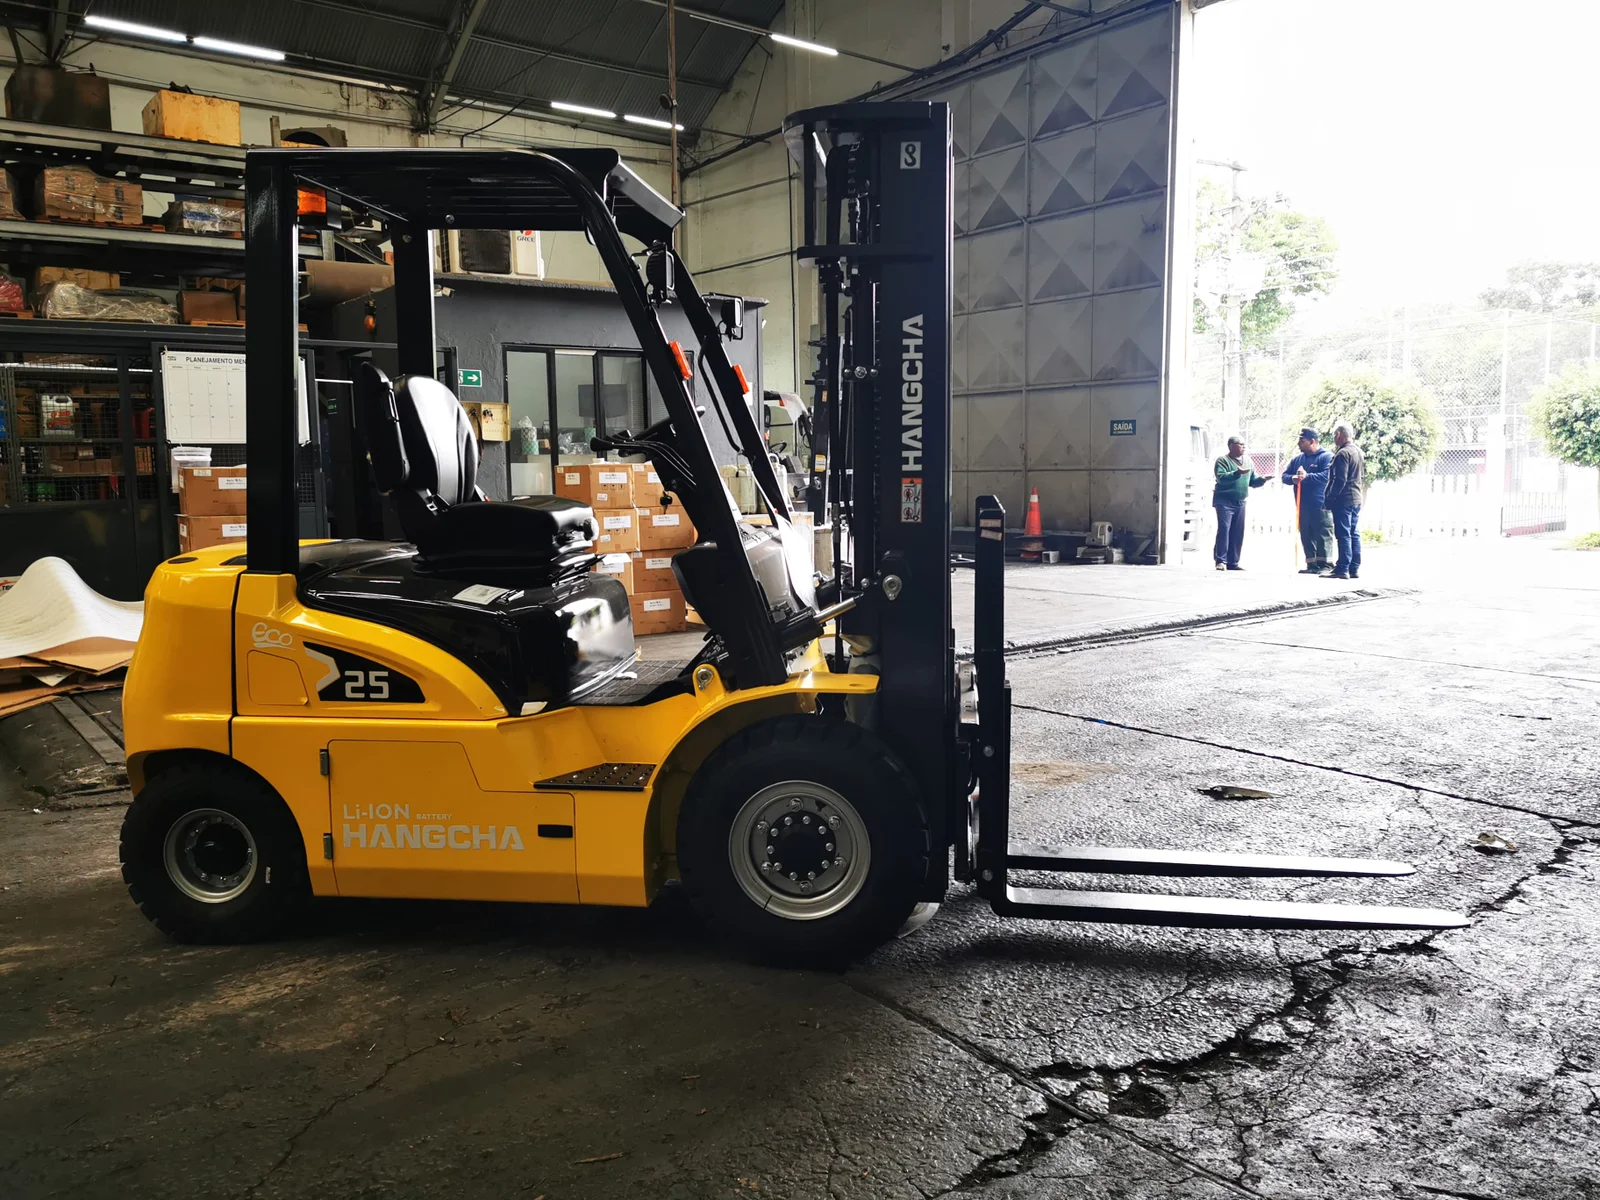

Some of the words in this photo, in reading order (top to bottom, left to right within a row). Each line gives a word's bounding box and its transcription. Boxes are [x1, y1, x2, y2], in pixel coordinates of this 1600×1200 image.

[185, 356, 233, 364] PLANEJAMENTO
[902, 313, 923, 471] HANGCHA
[1113, 422, 1133, 431] SAÍDA
[344, 670, 390, 699] 25
[343, 803, 411, 820] Li-ION
[416, 813, 452, 821] BATTERY
[342, 823, 525, 850] HANGCHA
